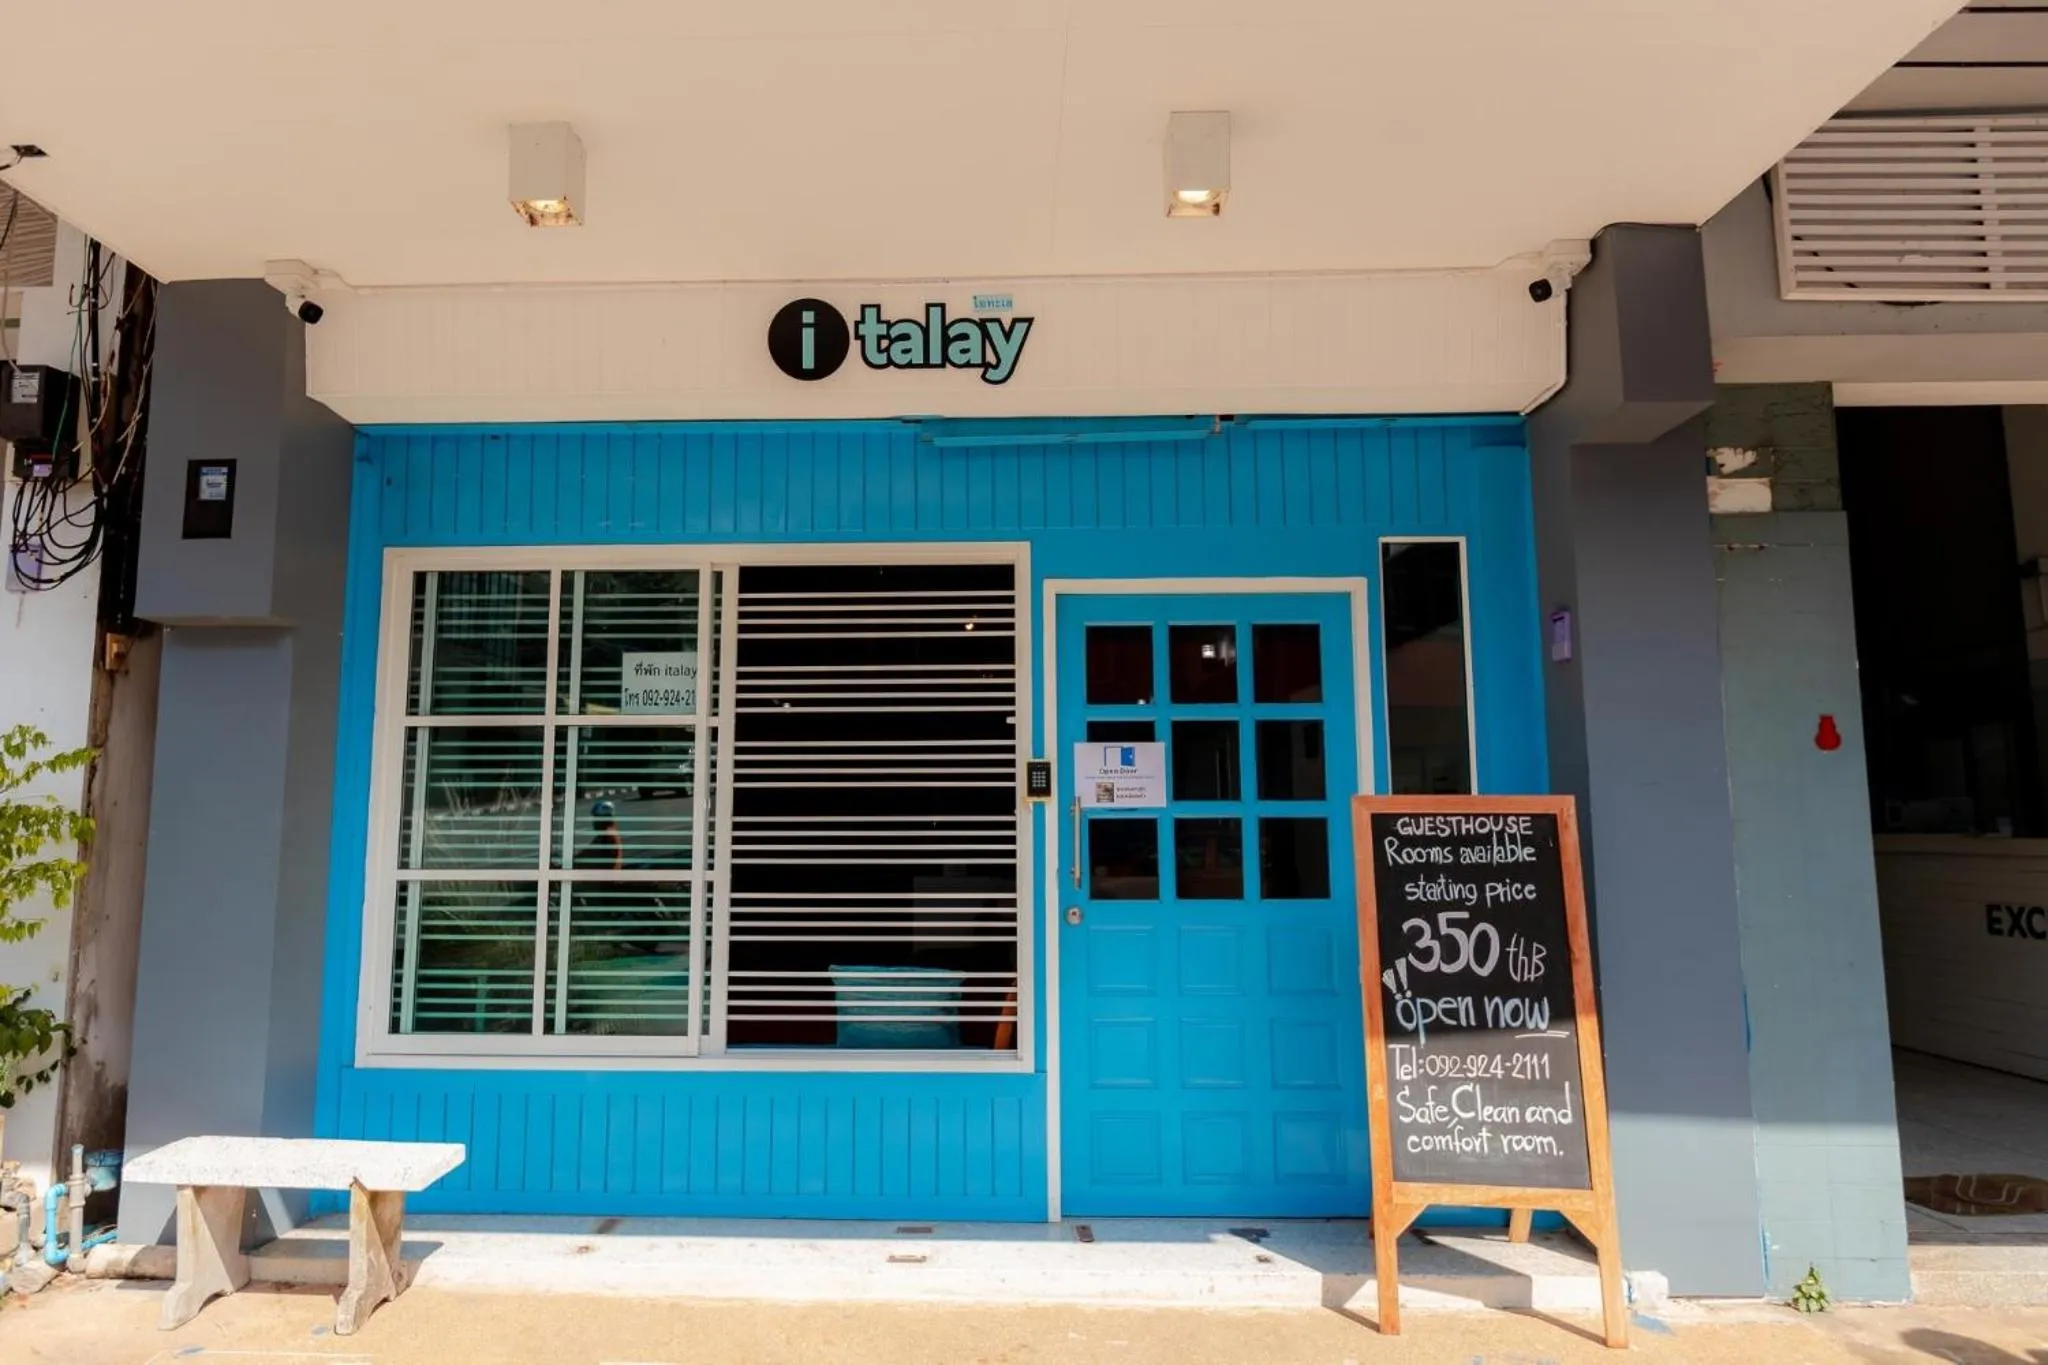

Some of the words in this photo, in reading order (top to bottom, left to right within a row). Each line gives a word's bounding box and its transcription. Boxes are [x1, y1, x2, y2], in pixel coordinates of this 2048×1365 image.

[854, 303, 1035, 385] talay
[664, 663, 697, 679] italay
[1396, 816, 1534, 836] GUESTHOUSE
[1384, 836, 1453, 867] Rooms
[1460, 829, 1537, 868] available
[1401, 911, 1500, 977] 350
[1396, 996, 1476, 1048] open
[1484, 996, 1550, 1031] now
[1525, 1081, 1573, 1125] and
[1407, 1126, 1491, 1155] comfort
[1500, 1134, 1565, 1156] room.
